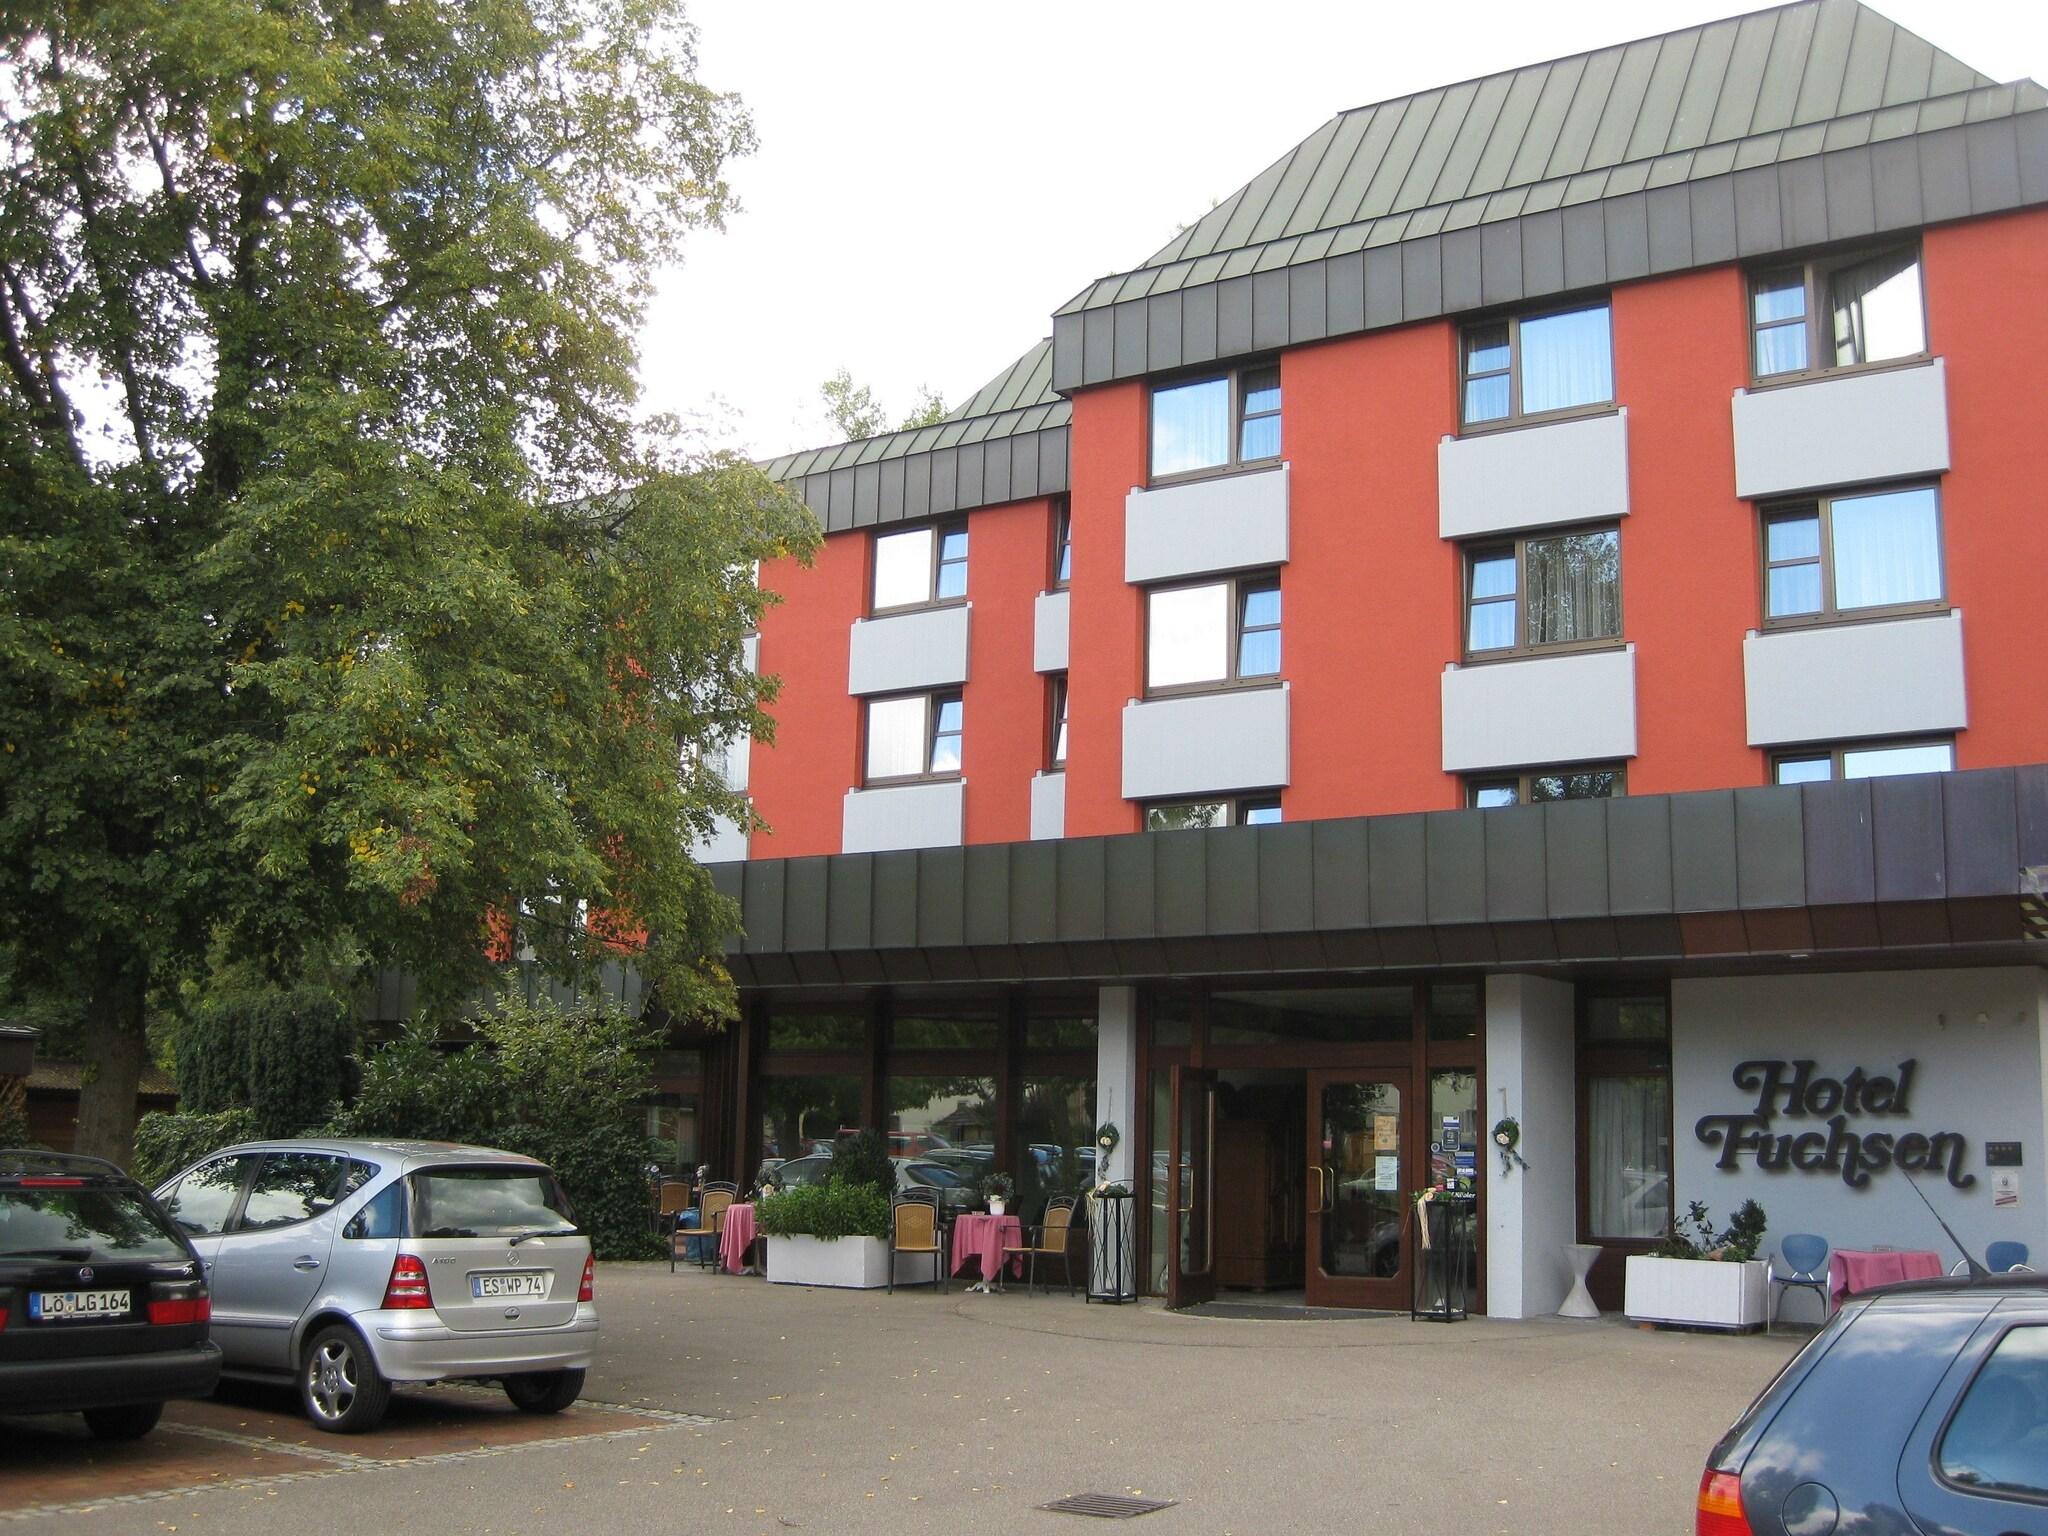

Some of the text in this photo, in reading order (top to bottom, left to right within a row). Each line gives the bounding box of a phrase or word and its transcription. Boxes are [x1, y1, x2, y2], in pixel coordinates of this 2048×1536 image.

[1732, 1058, 1916, 1115] Hotel
[1694, 1114, 1976, 1188] Fuchsen
[42, 1292, 129, 1313] LÖ LG 164
[483, 1276, 541, 1294] ES WP 74
